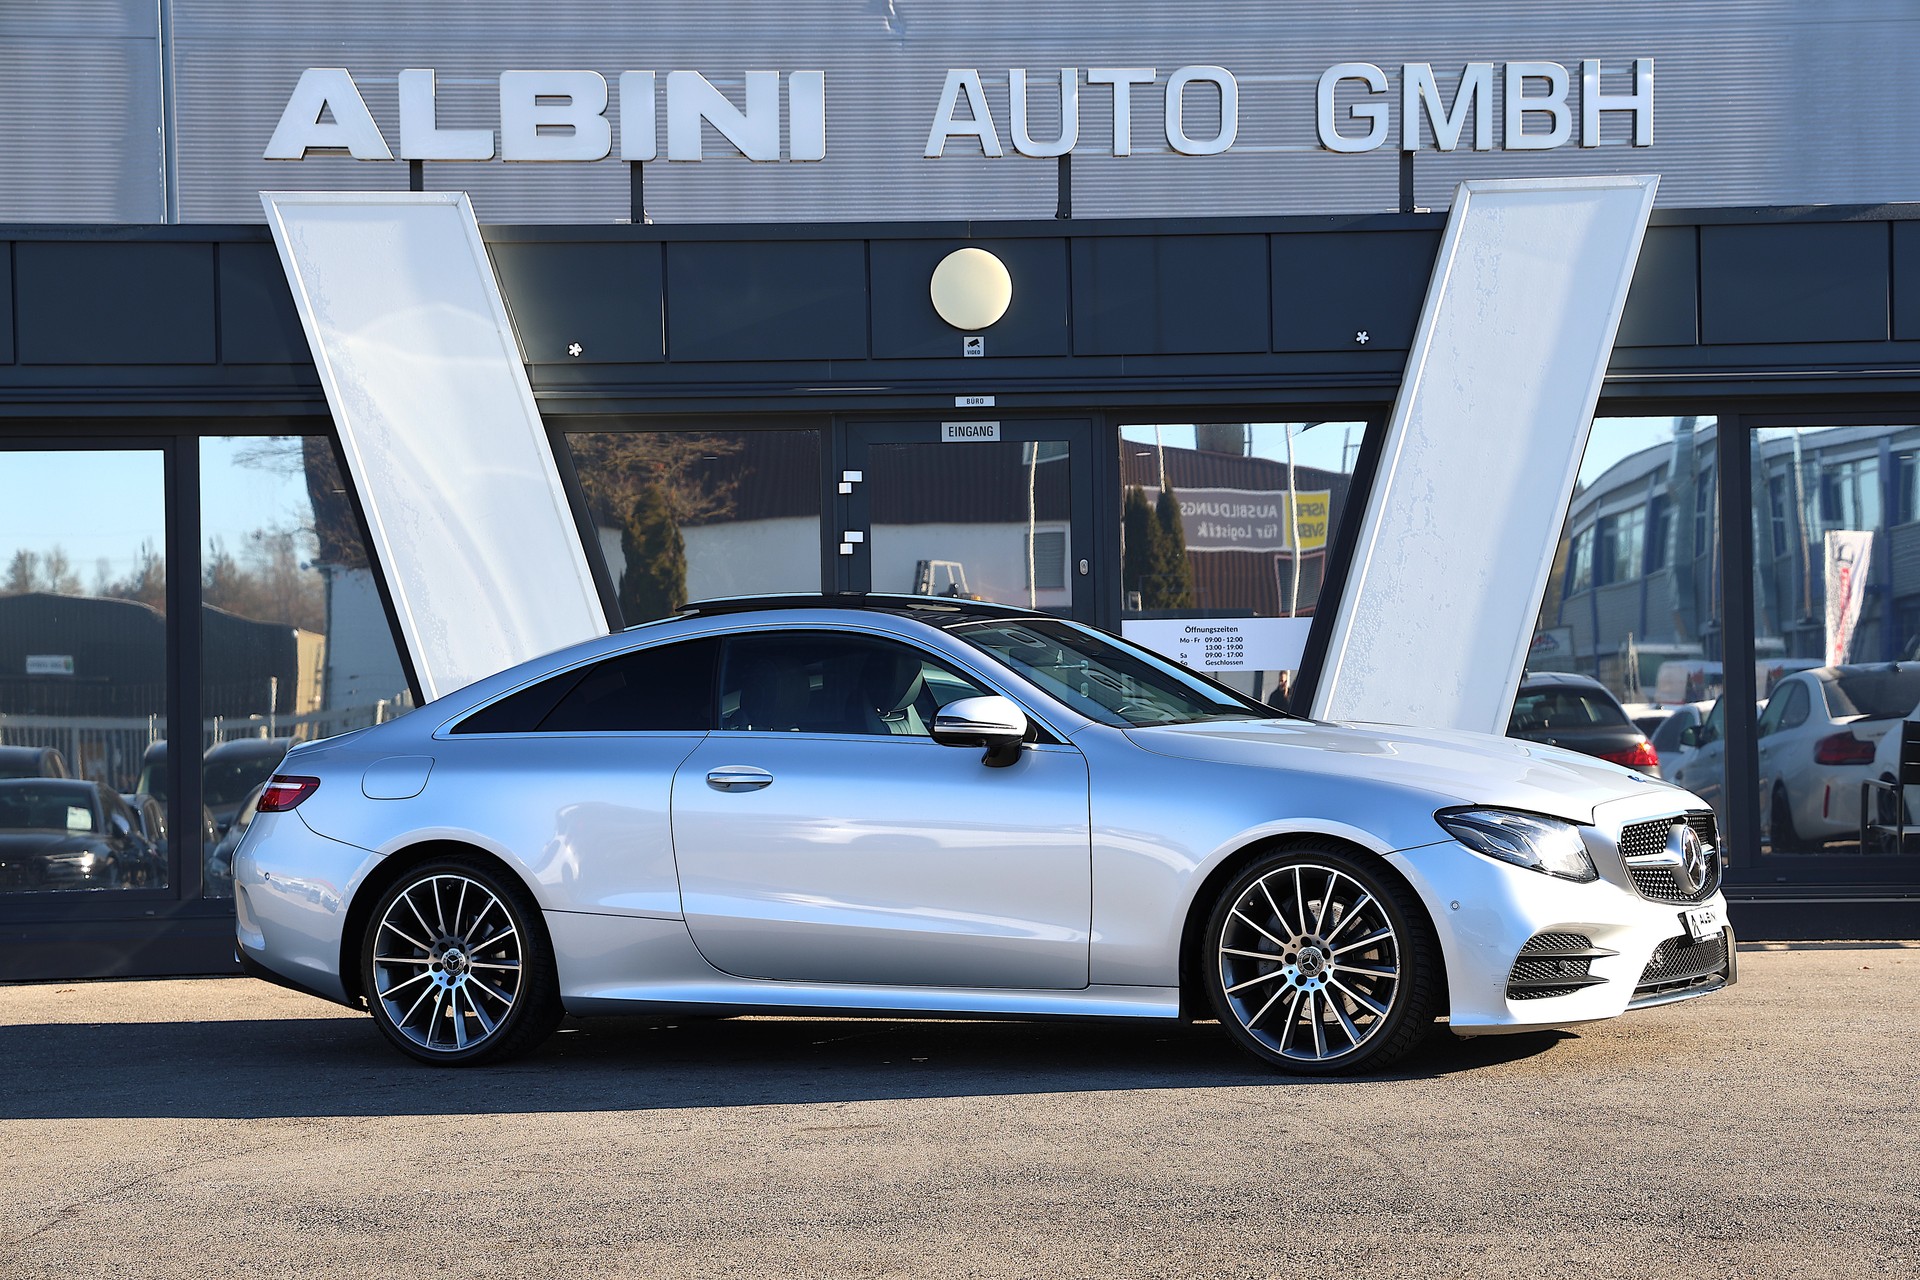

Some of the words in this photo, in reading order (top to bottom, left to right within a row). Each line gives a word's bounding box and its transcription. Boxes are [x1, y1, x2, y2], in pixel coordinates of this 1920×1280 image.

[263, 67, 826, 162] ALBINI
[923, 65, 1239, 158] AUTO
[1316, 57, 1655, 153] GMBH
[966, 396, 984, 405] BÜRO
[948, 425, 994, 437] EINGANG
[1184, 625, 1238, 634] Öffnungszeiten
